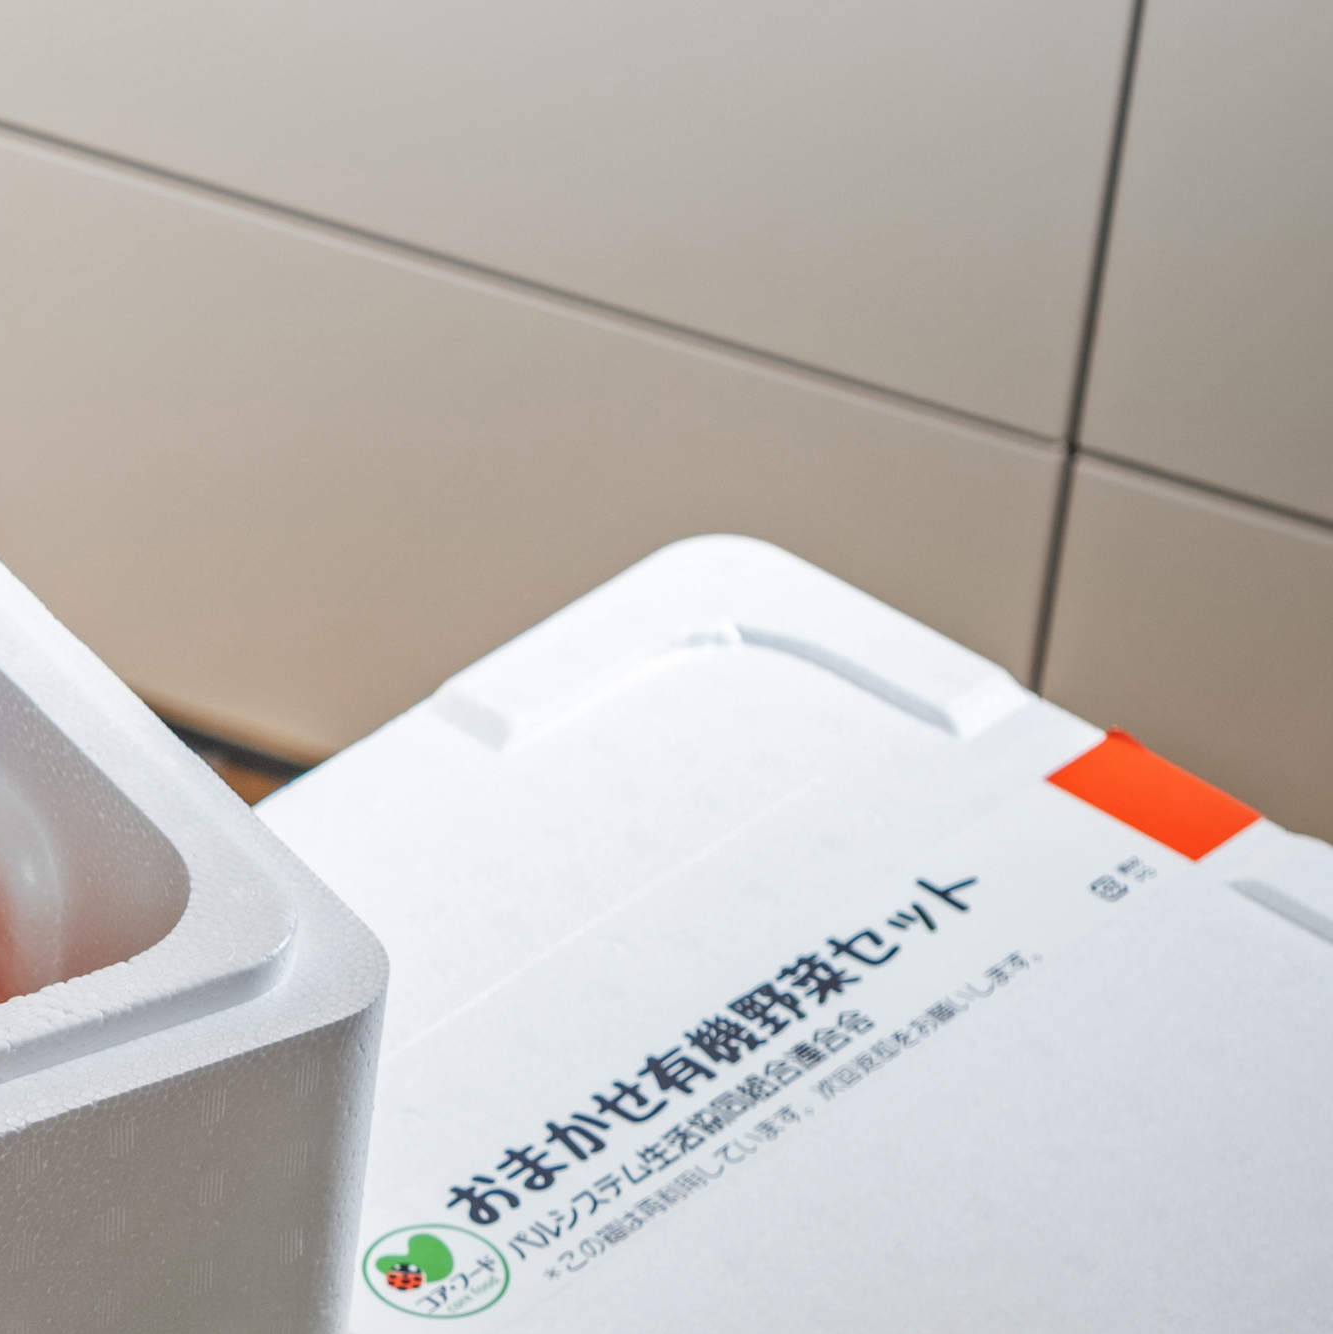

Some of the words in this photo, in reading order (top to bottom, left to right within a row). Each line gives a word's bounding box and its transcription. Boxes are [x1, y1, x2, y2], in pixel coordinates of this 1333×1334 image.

[446, 876, 978, 1225] おまかせ有機野菜セット
[507, 1008, 876, 1260] パルシステム生活協同組合連合会
[414, 1254, 497, 1315] コア・フード
